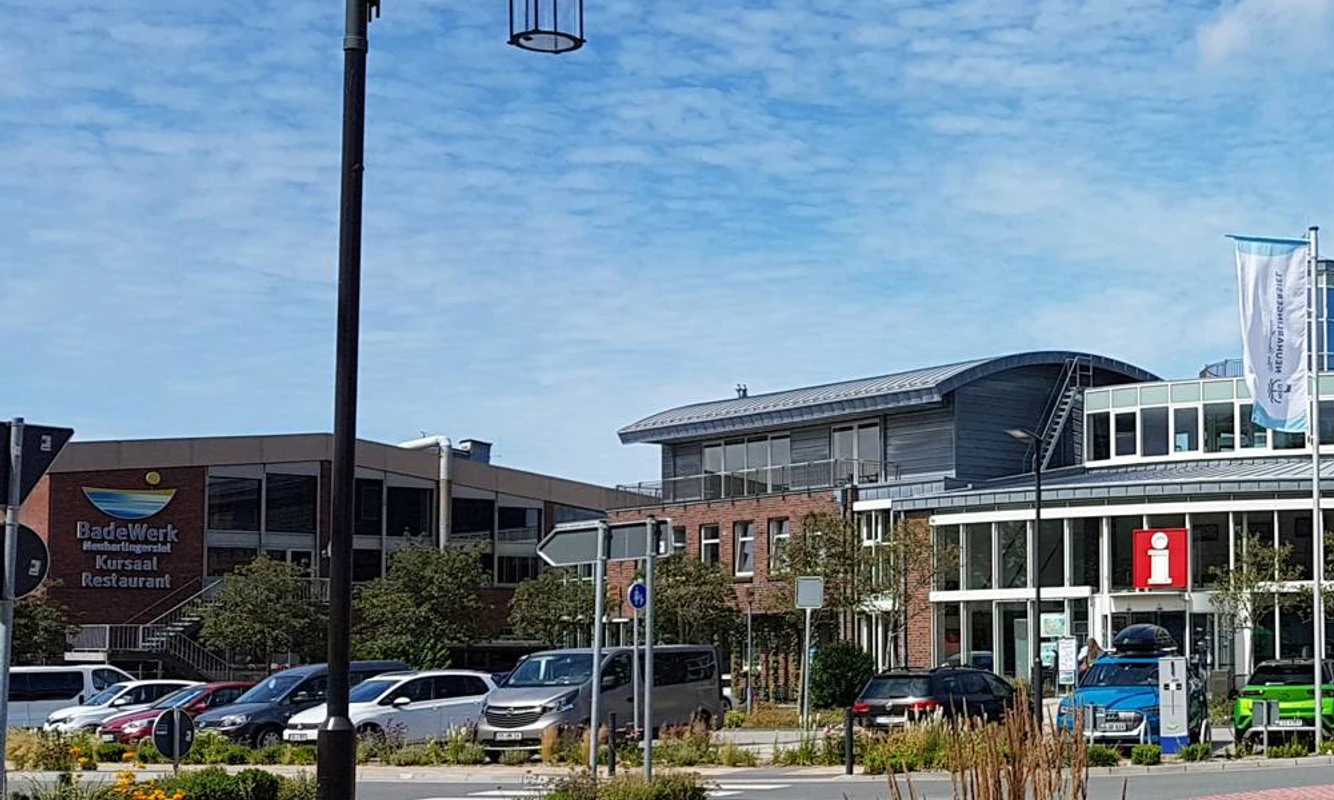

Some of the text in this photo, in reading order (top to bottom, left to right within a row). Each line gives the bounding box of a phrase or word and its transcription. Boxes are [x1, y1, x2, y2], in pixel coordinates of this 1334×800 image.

[77, 521, 179, 542] BadeWerk
[96, 554, 158, 571] Kursaal
[81, 571, 171, 588] Restaurant
